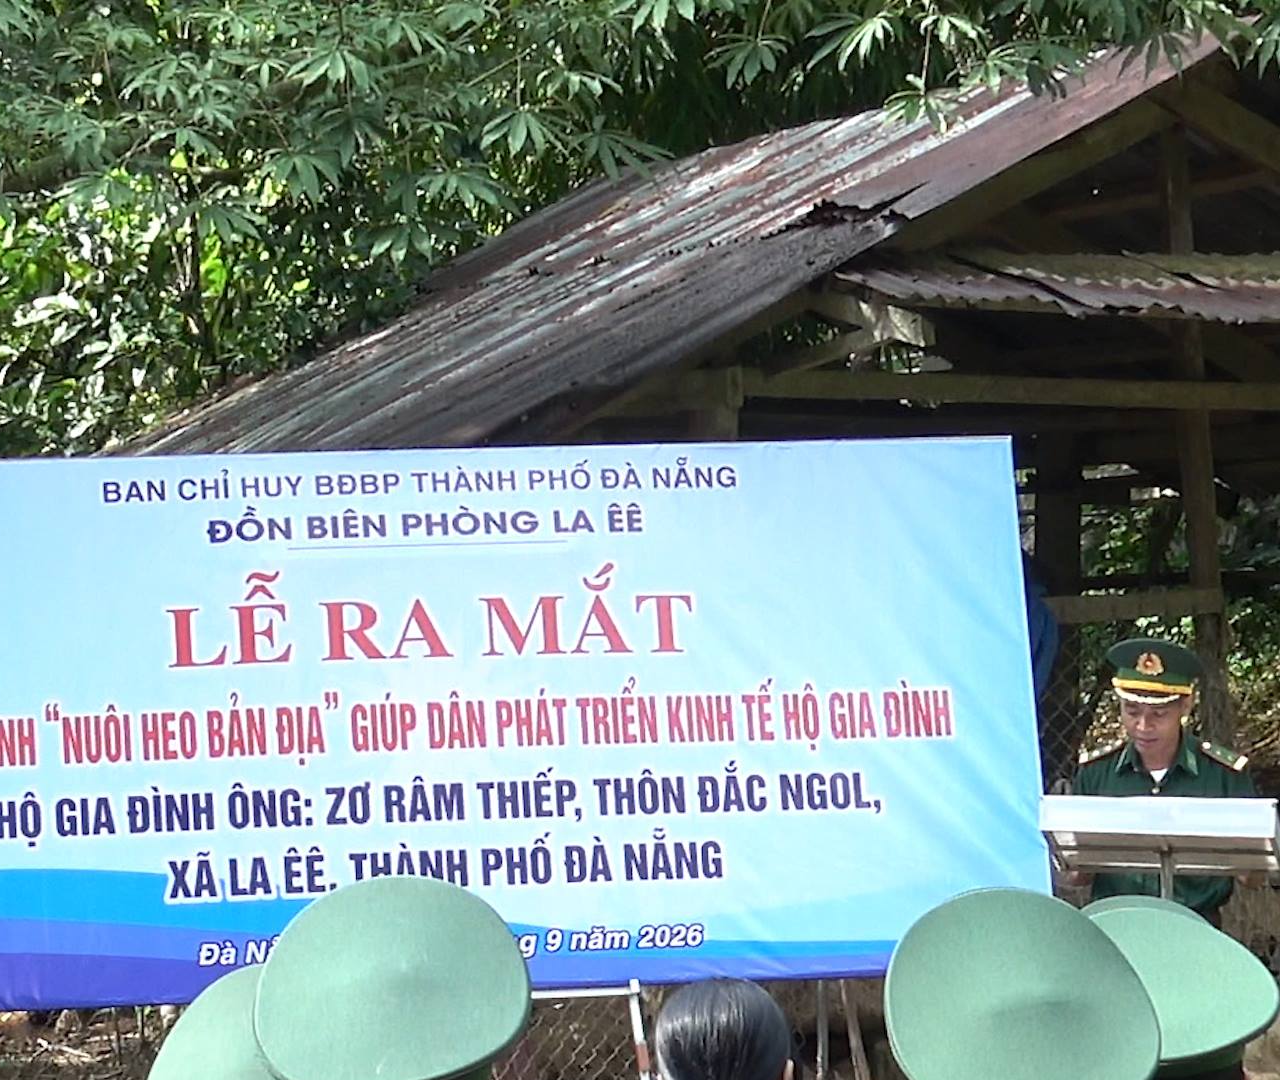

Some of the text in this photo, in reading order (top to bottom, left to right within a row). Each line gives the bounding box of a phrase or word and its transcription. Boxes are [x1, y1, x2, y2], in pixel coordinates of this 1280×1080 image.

[103, 457, 738, 504] BAN CHỈ HUY BĐBP THÀNH PHỐ ĐÀ NẴNG
[207, 503, 642, 544] ĐỒN BIÊN PHÒNG LA ÊÊ
[166, 562, 693, 668] LỄ RA MẮT
[139, 710, 199, 762] HEO
[205, 692, 269, 760] BẢN
[349, 695, 418, 753] GIÚP
[426, 690, 489, 751] DÂN
[495, 688, 568, 749] PHÁT
[575, 676, 660, 746] TRIỂN
[666, 694, 736, 744] KINH
[740, 678, 776, 742] TẾ
[781, 684, 821, 753] HỘ
[827, 690, 878, 740] GIA
[882, 681, 953, 739] ĐÌNH
[55, 796, 117, 837] GIA
[126, 787, 215, 834] ĐÌNH
[228, 782, 314, 829] ÔNG:
[325, 781, 371, 826] ZƠ
[384, 775, 466, 823] RÂM
[475, 767, 583, 821] THIẾP,
[592, 768, 687, 816] THÔN
[697, 760, 768, 813] ĐẮC
[779, 772, 882, 813] NGOL,
[169, 850, 218, 900] XÃ
[229, 856, 273, 897] LA
[481, 834, 552, 887] PHỐ
[564, 836, 613, 884] ĐÀ
[623, 827, 724, 881] NẴNG
[197, 940, 240, 966] Đà
[545, 928, 564, 952] 9
[570, 926, 631, 951] năm
[636, 923, 705, 949] 2026
